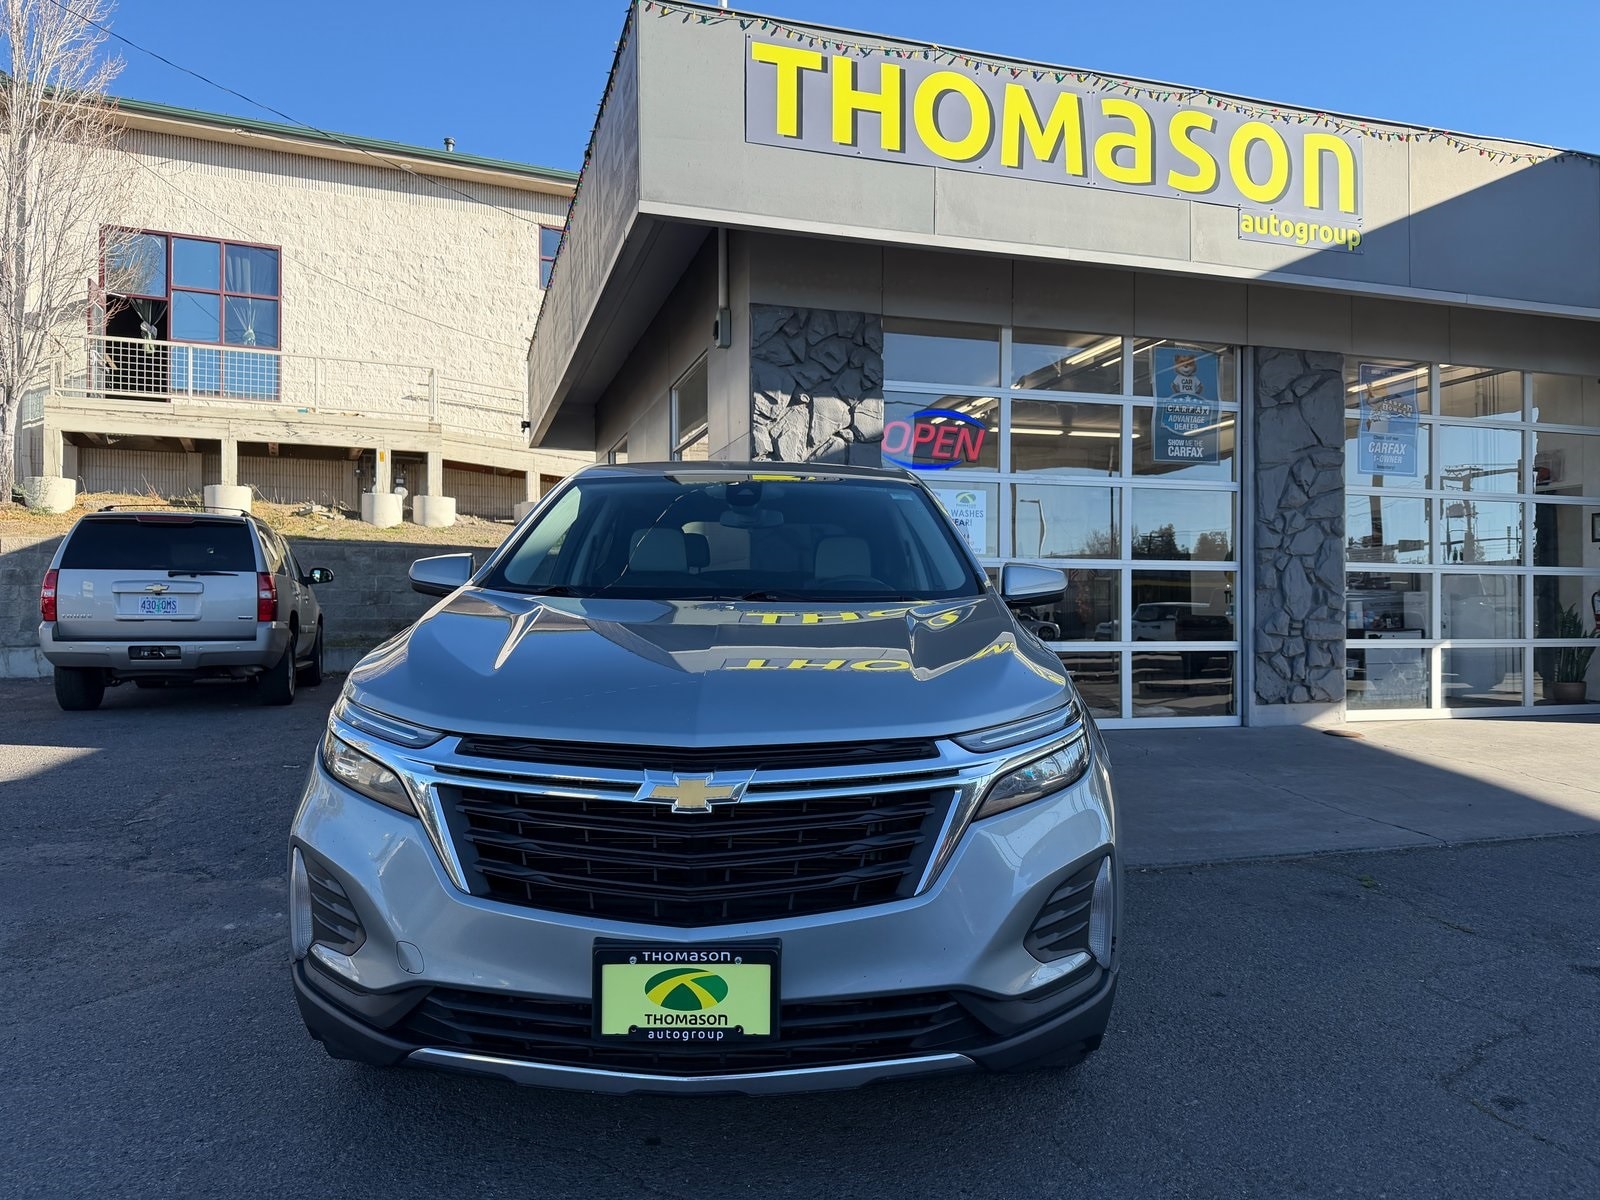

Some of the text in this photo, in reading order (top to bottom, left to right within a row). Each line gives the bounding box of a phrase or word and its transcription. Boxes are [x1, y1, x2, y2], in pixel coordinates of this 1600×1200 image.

[1240, 213, 1361, 251] autogroup
[1167, 405, 1210, 415] CARFAX
[1168, 414, 1205, 423] ADVANTAGE
[1174, 423, 1199, 431] DEALER
[881, 421, 986, 461] OPEN
[1167, 446, 1204, 458] CARFAX
[1368, 441, 1407, 455] CARFAX
[950, 509, 984, 518] WASHES
[953, 518, 973, 527] EAR!
[141, 600, 157, 610] 430
[648, 1029, 724, 1041] autogroup
